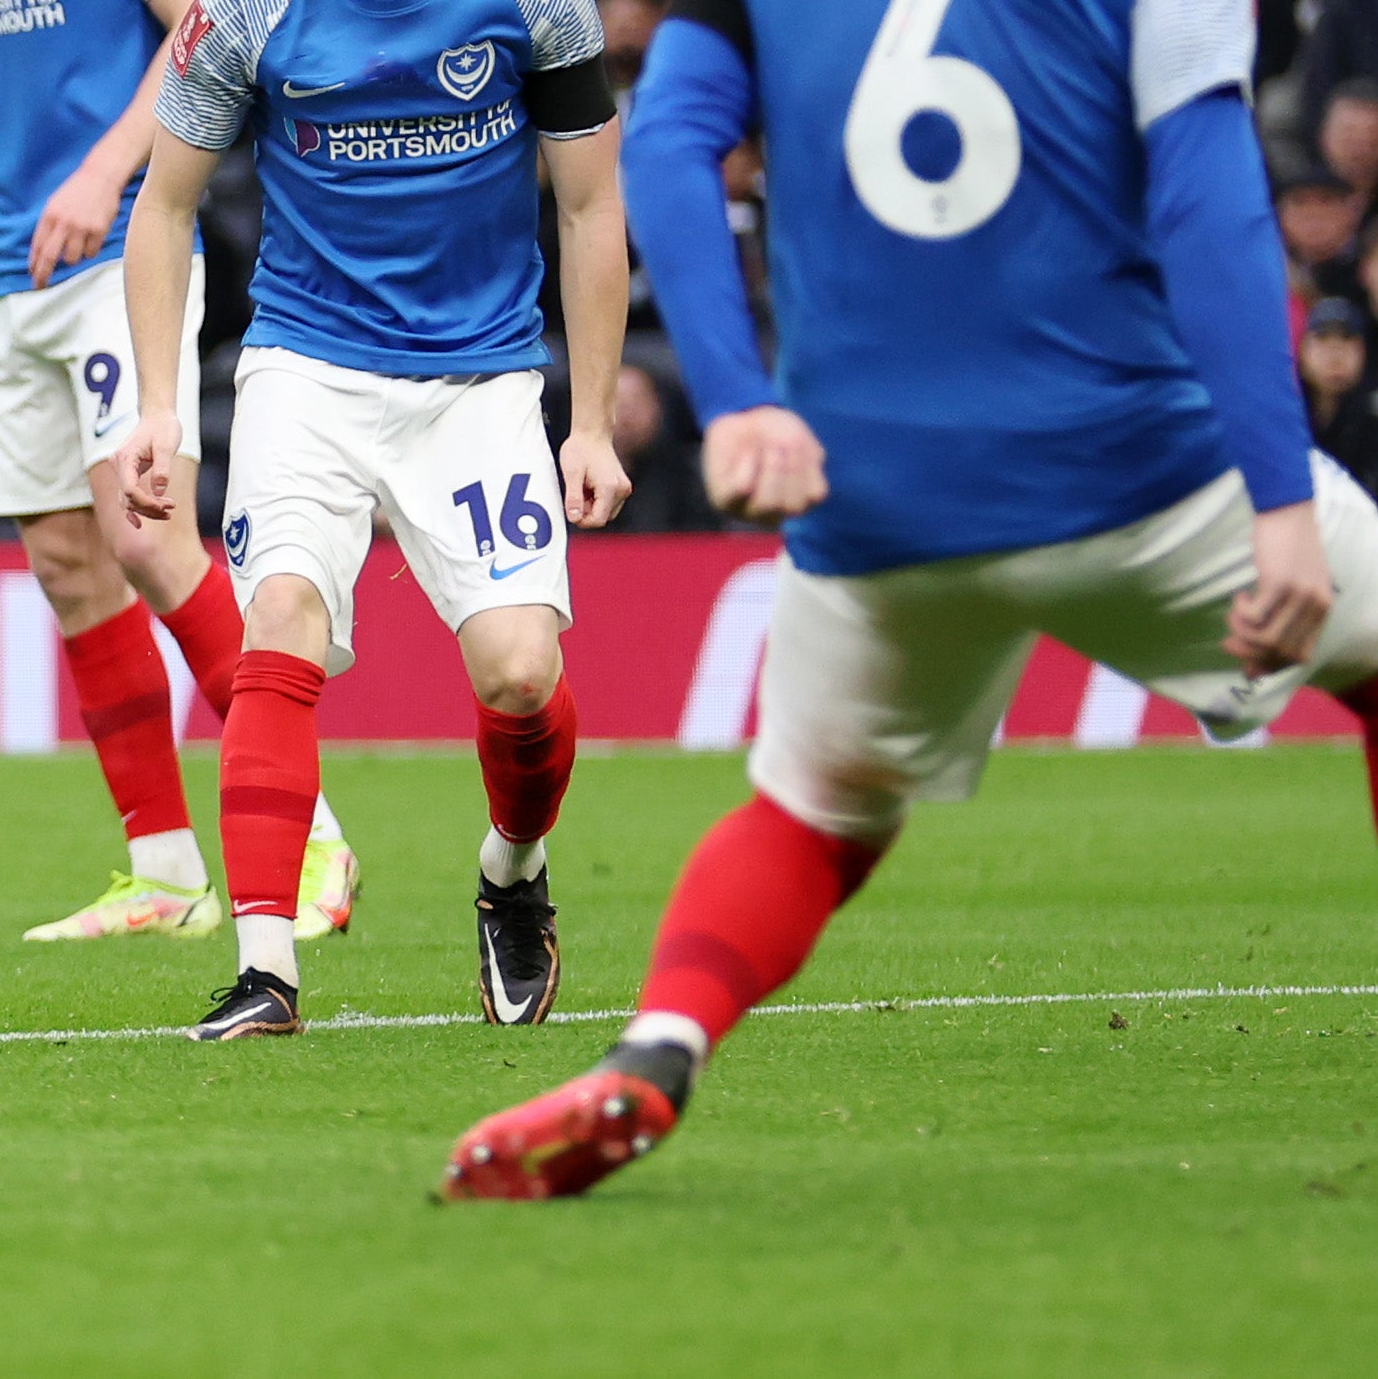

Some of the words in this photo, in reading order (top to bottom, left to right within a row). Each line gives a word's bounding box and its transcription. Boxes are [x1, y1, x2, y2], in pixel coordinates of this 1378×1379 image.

[328, 110, 517, 161] PORTSMOUTH
[84, 352, 120, 418] 9
[452, 473, 552, 557] 16
